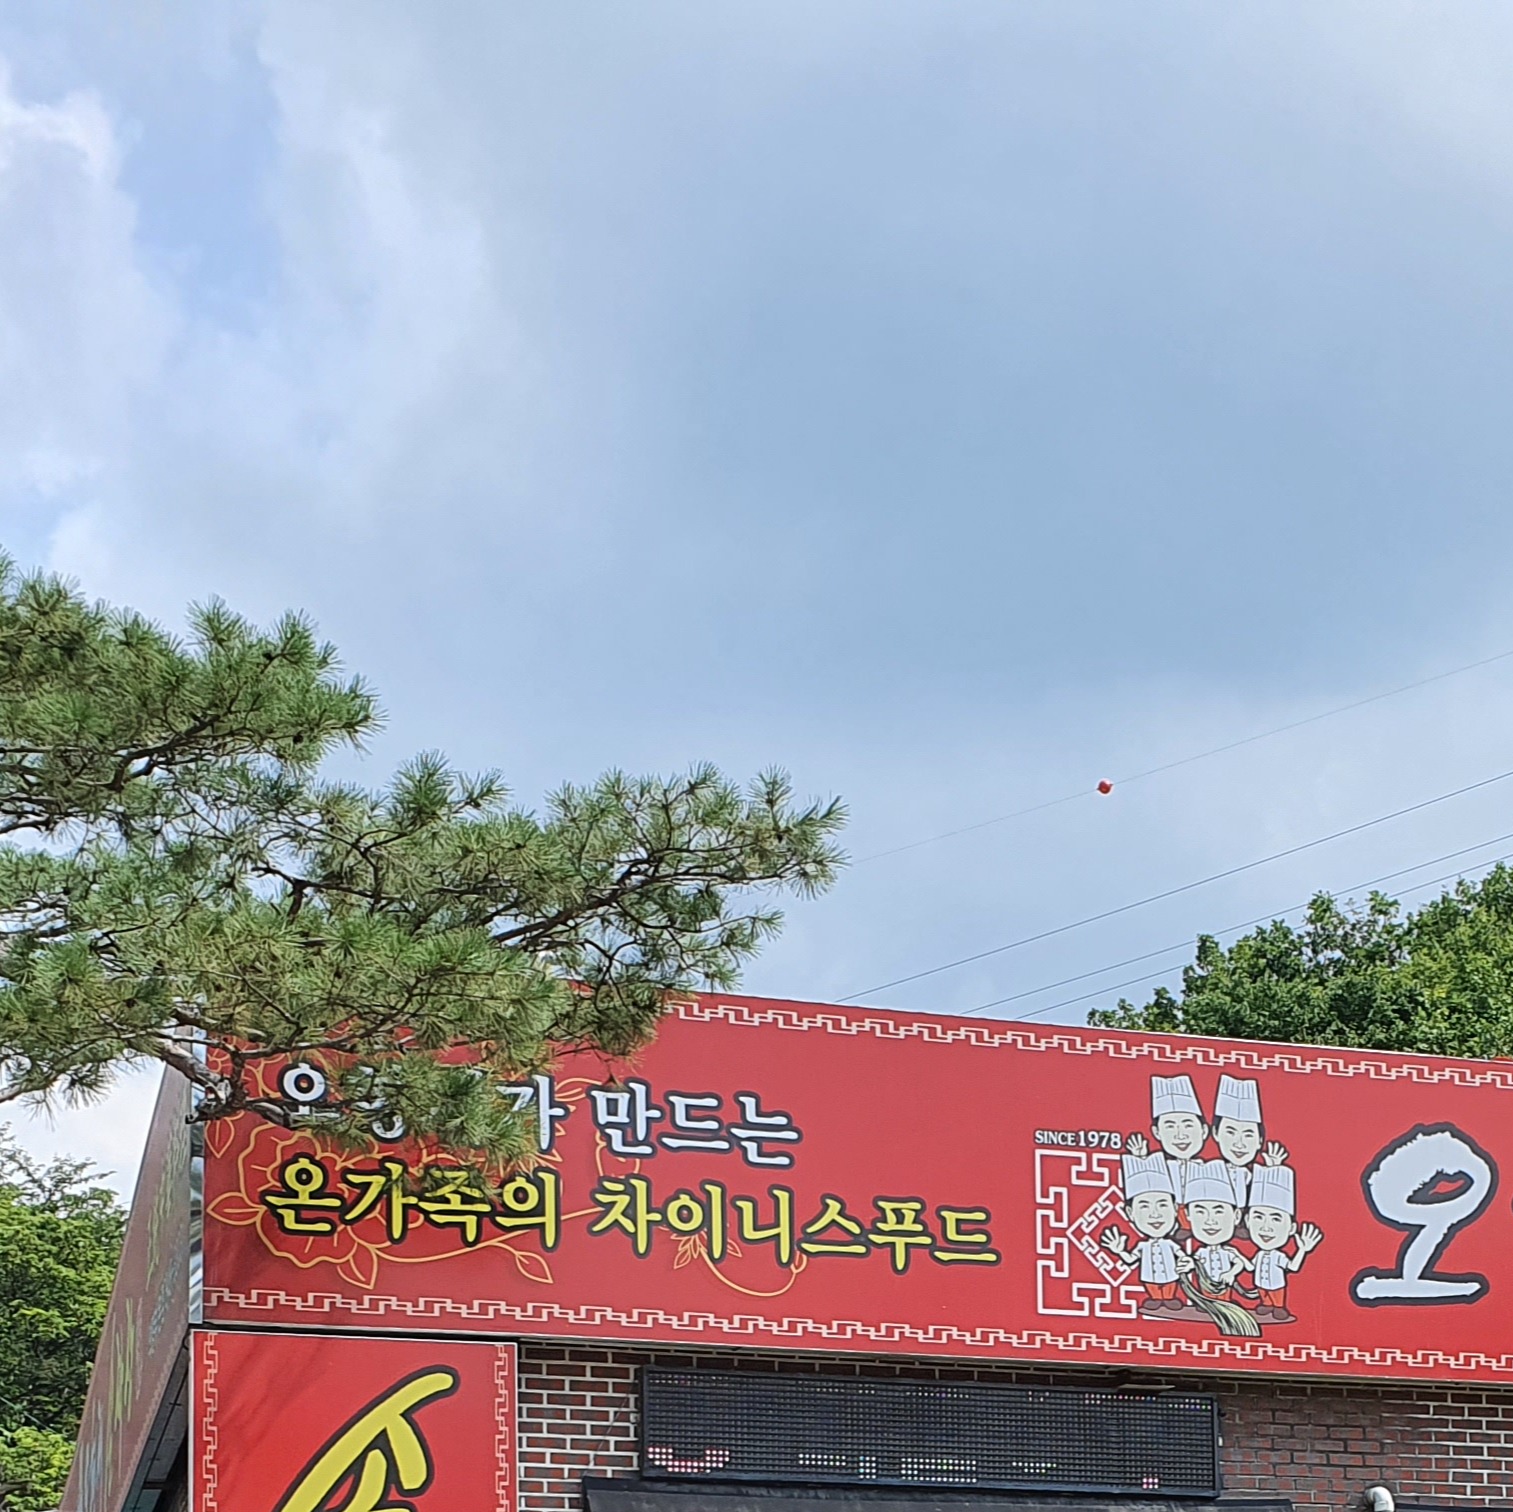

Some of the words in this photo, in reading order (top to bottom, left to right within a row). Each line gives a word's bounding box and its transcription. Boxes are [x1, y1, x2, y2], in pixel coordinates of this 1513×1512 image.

[591, 1083, 799, 1165] 만드는
[1034, 1130, 1076, 1146] SINCE
[1078, 1131, 1122, 1149] 1978
[266, 1157, 556, 1247] 온가족의
[593, 1175, 997, 1270] 차이니스푸드
